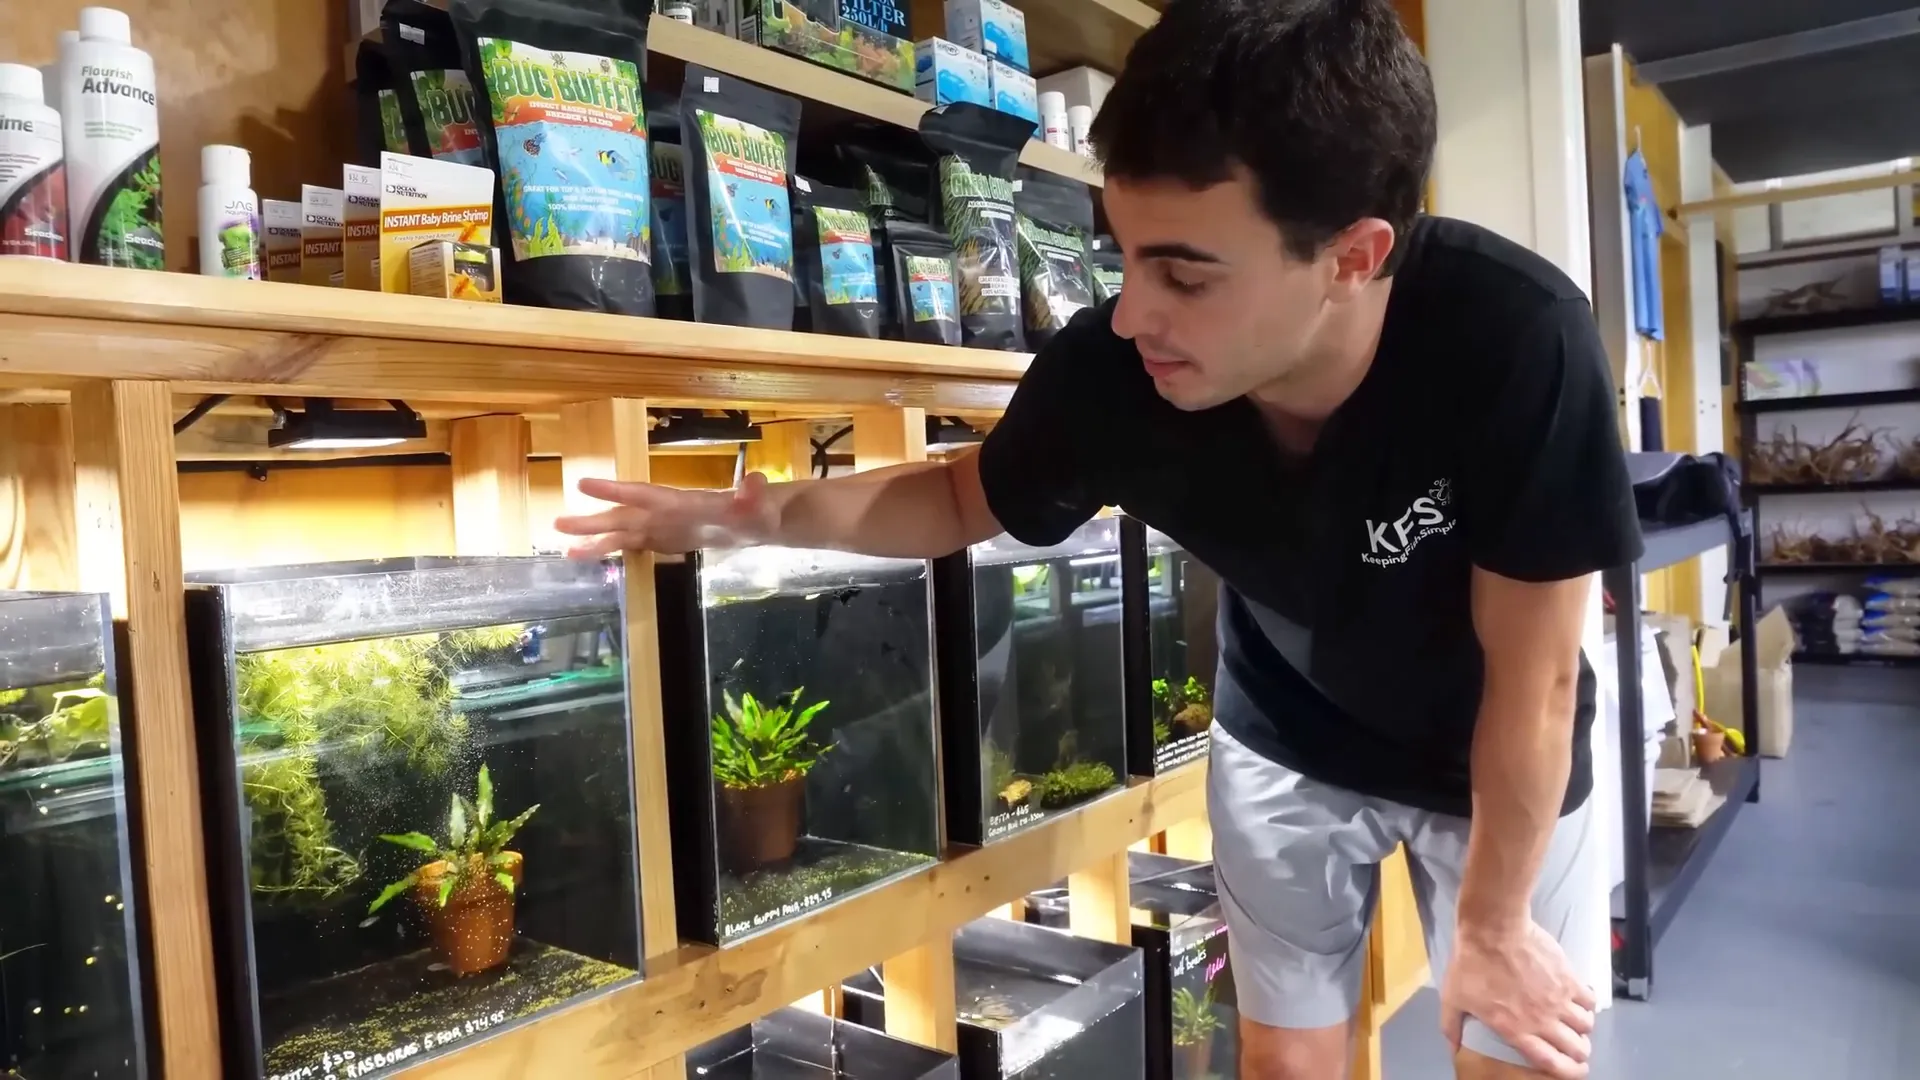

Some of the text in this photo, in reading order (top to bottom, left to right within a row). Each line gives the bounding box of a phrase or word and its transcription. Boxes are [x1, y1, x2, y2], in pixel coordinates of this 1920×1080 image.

[841, 0, 906, 27] ILTER
[842, 5, 889, 33] 250L/h
[81, 65, 133, 81] Flourish
[81, 77, 155, 106] Advance
[493, 57, 639, 117] BUG BUFFET
[0, 114, 34, 133] ime
[396, 184, 416, 192] OCEAN
[396, 190, 427, 199] NUTRITION
[384, 209, 489, 228] INSTANT Baby Brine Shrimp
[305, 241, 340, 254] INSTANT
[1365, 497, 1444, 553] KFS
[323, 1050, 355, 1073] $30
[347, 1041, 420, 1078] RASBORAS
[436, 1026, 462, 1046] FOR
